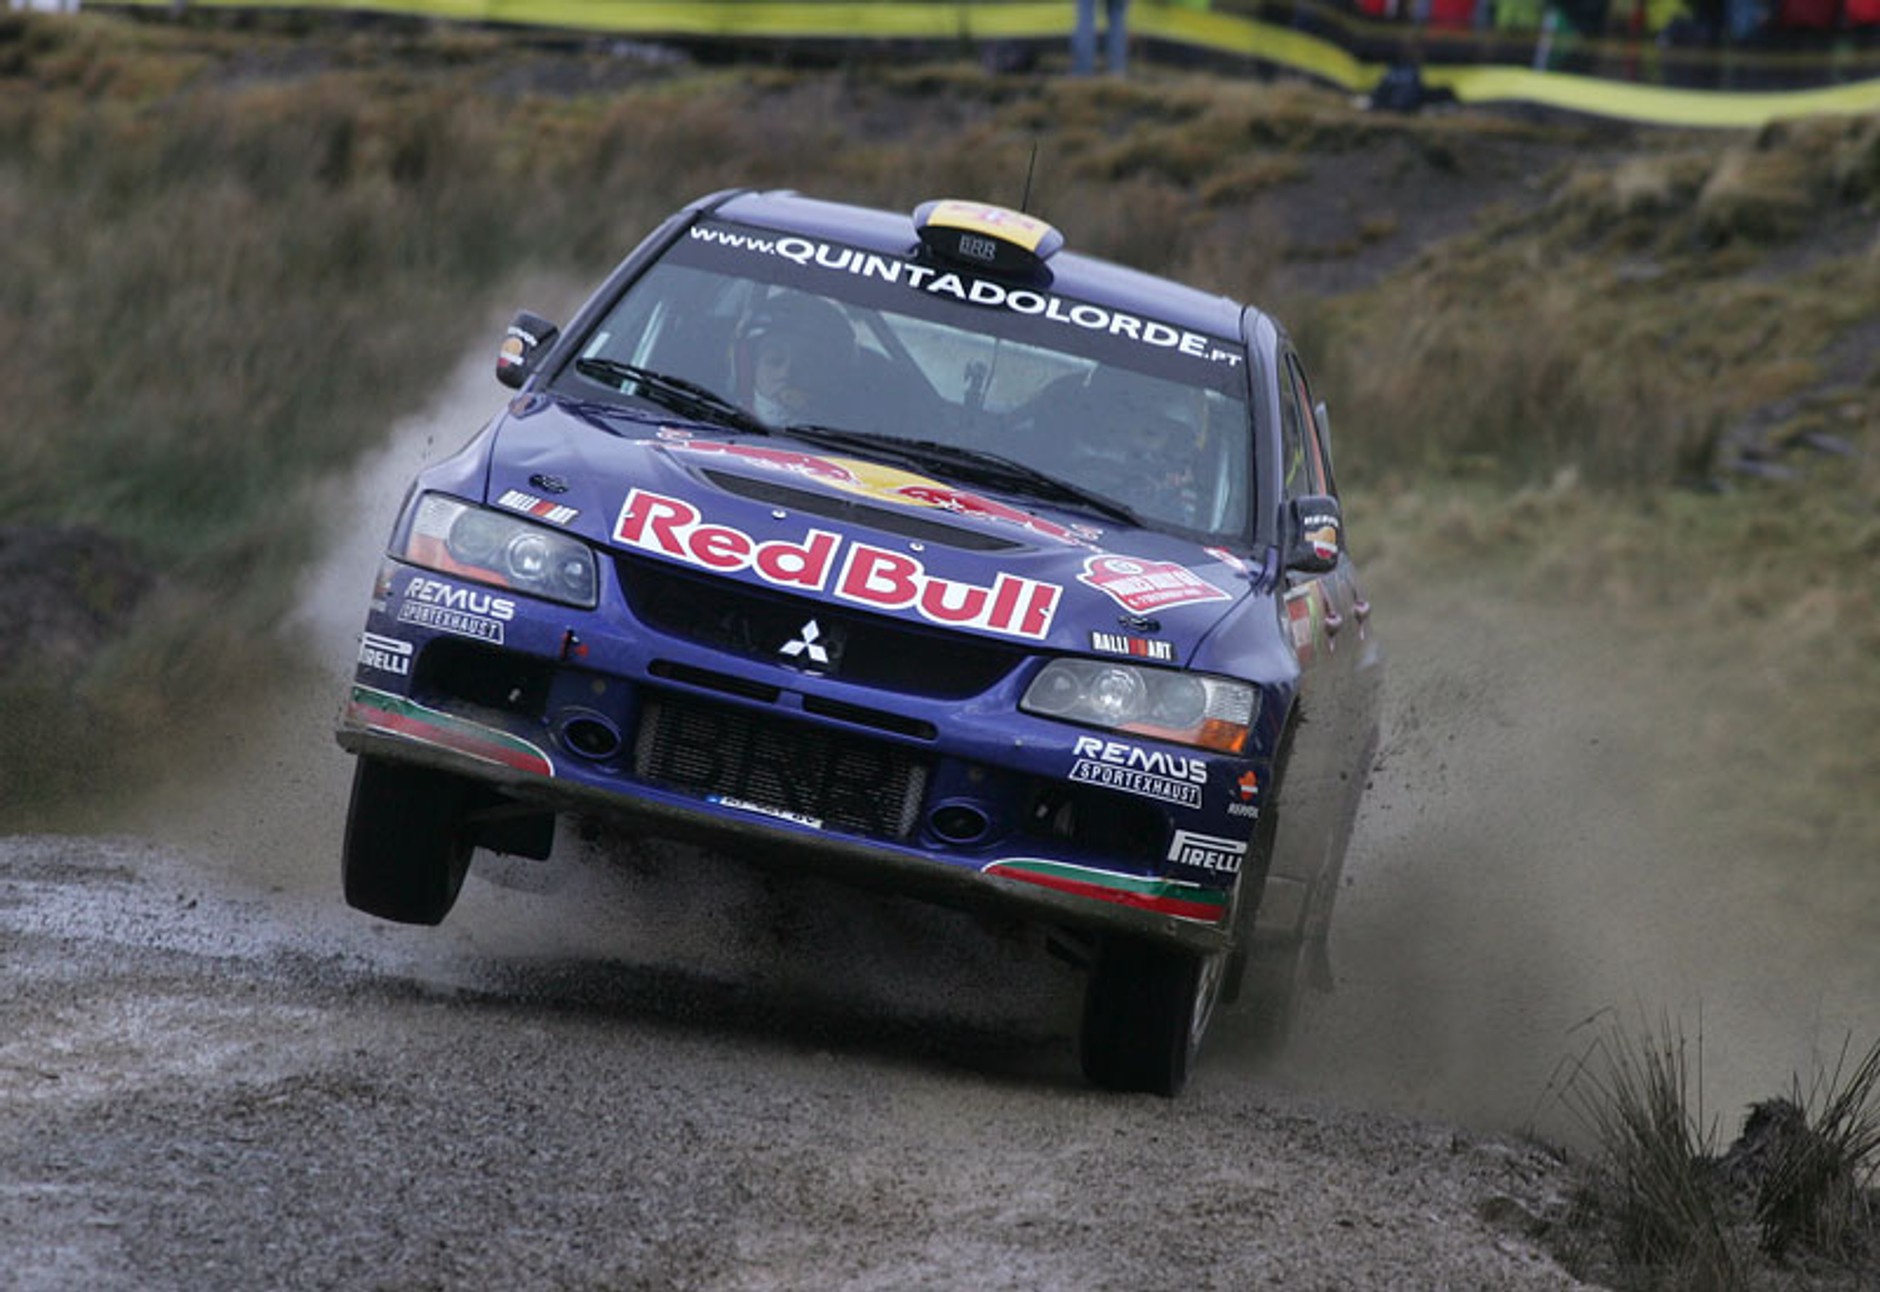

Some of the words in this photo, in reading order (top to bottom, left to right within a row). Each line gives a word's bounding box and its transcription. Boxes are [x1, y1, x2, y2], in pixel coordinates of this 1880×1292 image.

[690, 226, 1241, 366] www.QUINTADOLORDE.PT
[620, 490, 836, 589] Red
[839, 545, 1058, 638] Bull
[405, 577, 516, 621] REMUS
[1072, 735, 1208, 784] REMUS
[1080, 763, 1198, 803] SPORTEXHAUST
[1166, 828, 1247, 873] PIRELLI
